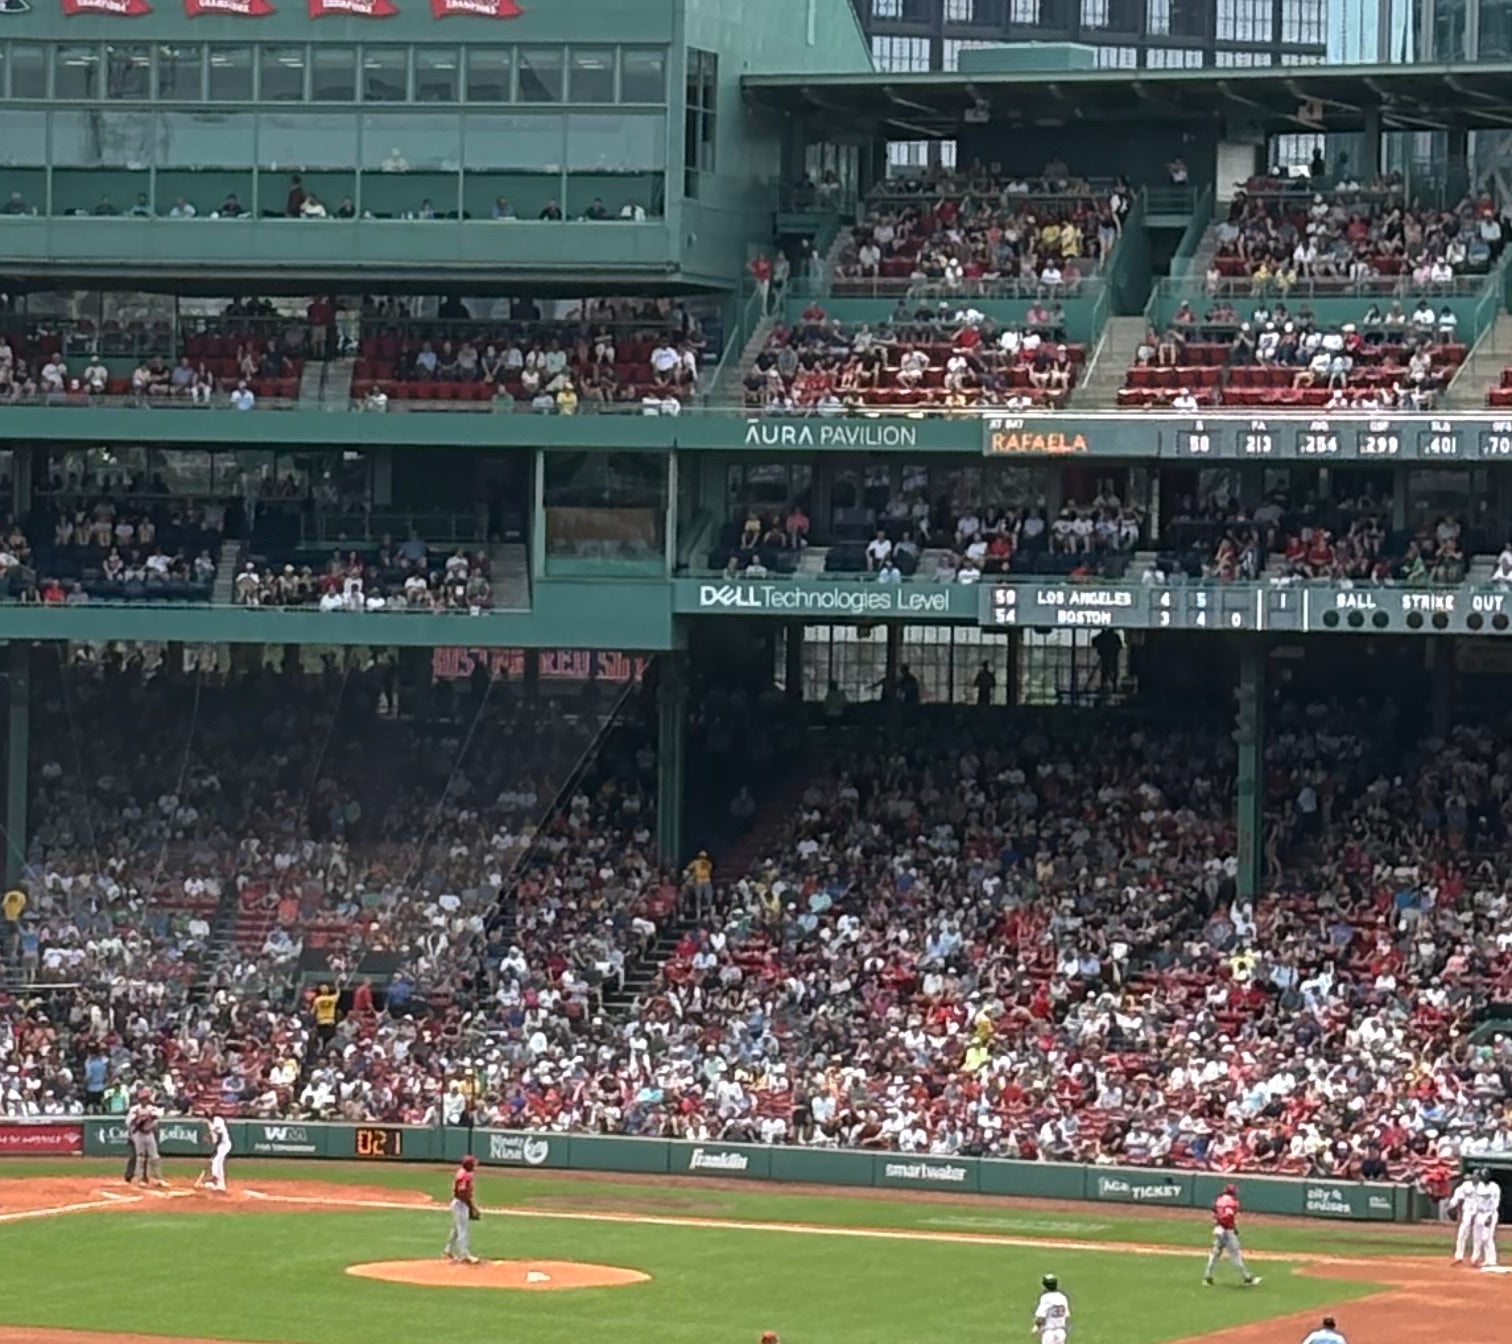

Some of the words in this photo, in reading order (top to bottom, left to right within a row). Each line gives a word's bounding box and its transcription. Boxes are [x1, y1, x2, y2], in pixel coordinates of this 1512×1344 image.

[820, 425, 916, 446] PAVILION
[991, 433, 1088, 453] RAFAELA
[1246, 435, 1272, 454] 213
[1359, 436, 1399, 454] .299
[1424, 436, 1457, 455] .401
[1483, 436, 1512, 455] .70
[700, 585, 762, 608] DELL
[760, 585, 891, 614] Technologies
[896, 588, 949, 612] Level
[1037, 591, 1065, 606] LOS
[1069, 591, 1132, 607] ANGELES
[1159, 591, 1171, 607] 4
[1195, 591, 1207, 608] 5
[1335, 592, 1377, 610] BALL
[1401, 594, 1455, 611] STRIKE
[1472, 595, 1504, 612] OUT
[1057, 609, 1112, 625] BOSTON
[1195, 611, 1207, 627] 4
[264, 1126, 308, 1142] WM
[490, 1147, 523, 1160] Nine
[689, 1148, 749, 1170] Franklin
[885, 1163, 967, 1182] smartwater
[1131, 1185, 1182, 1199] TICKET
